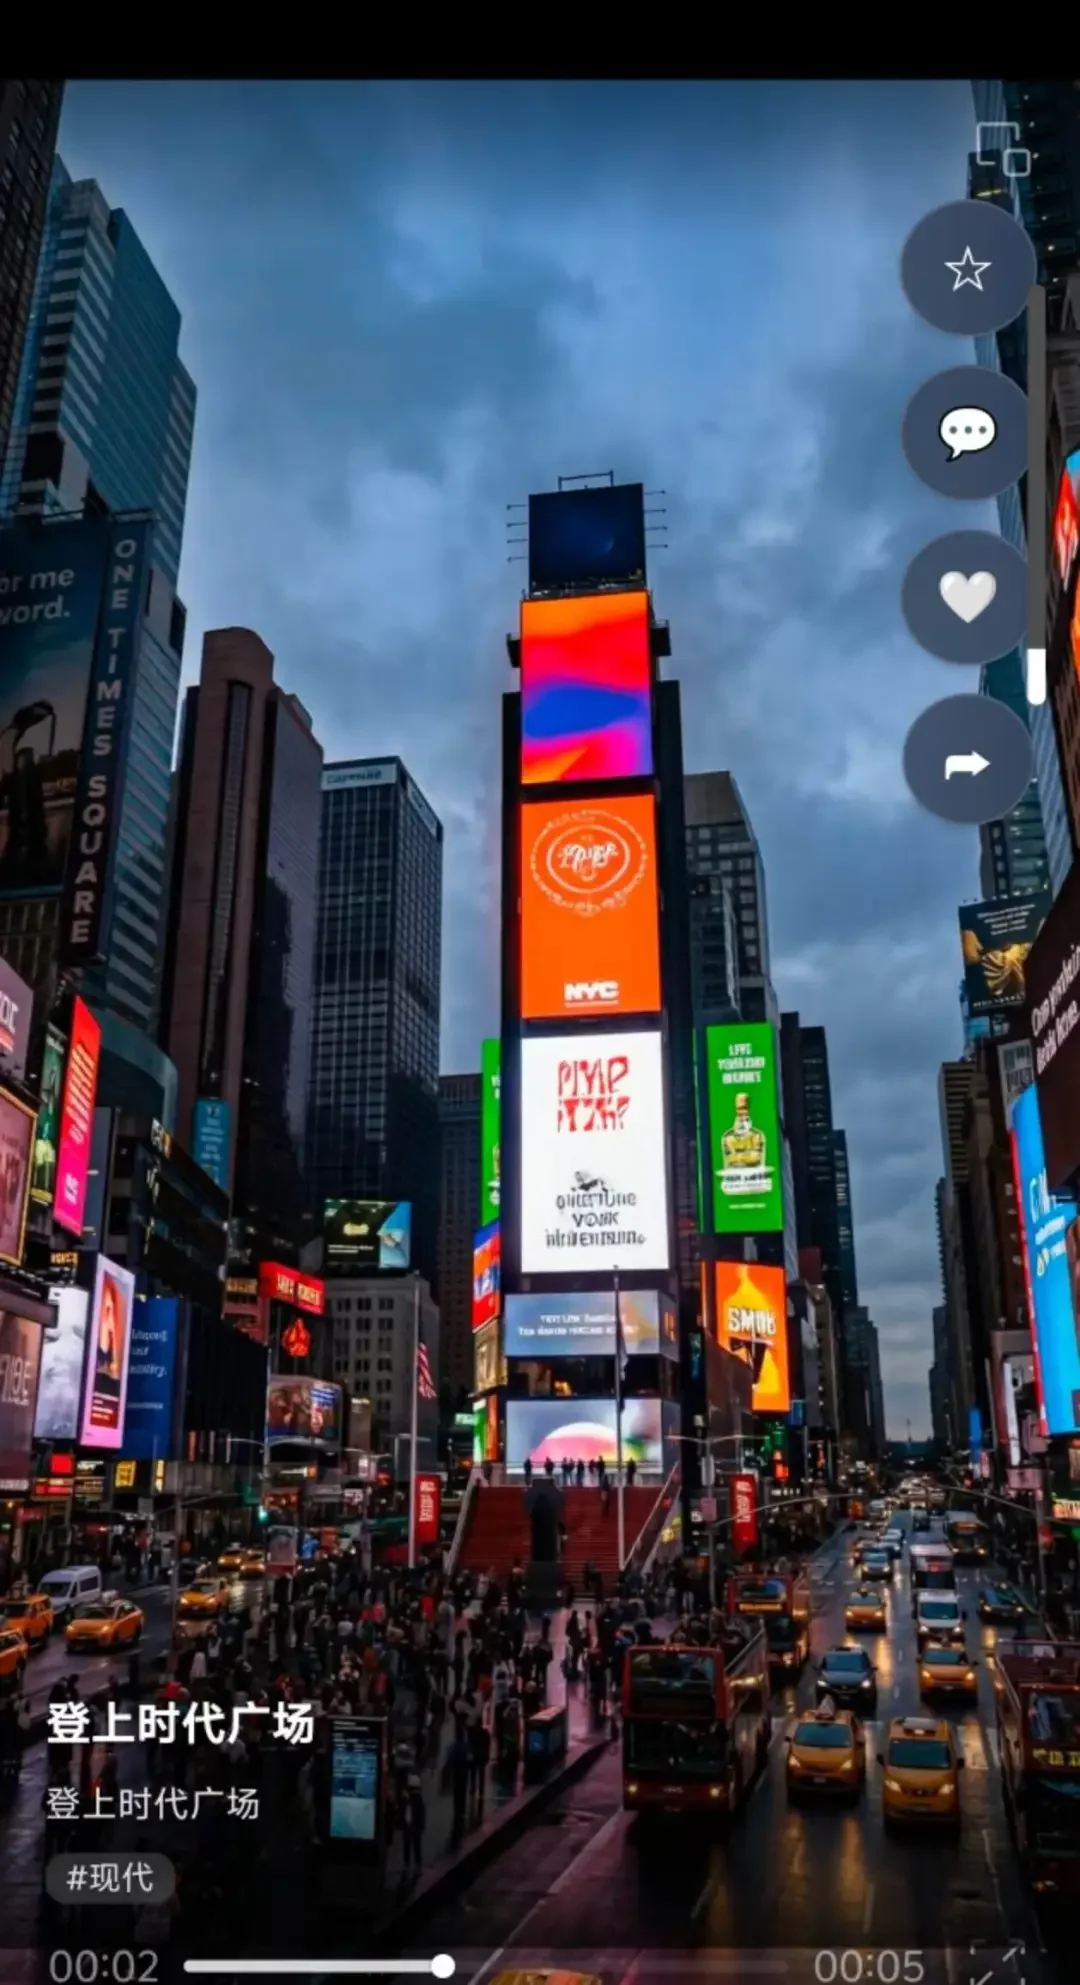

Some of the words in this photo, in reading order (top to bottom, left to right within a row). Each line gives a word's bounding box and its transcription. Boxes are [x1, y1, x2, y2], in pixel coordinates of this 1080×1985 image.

[30, 568, 75, 590] me
[110, 538, 137, 610] ONE
[93, 627, 126, 757] TIMES
[70, 775, 108, 945] SQUARE
[564, 980, 620, 1002] NYC
